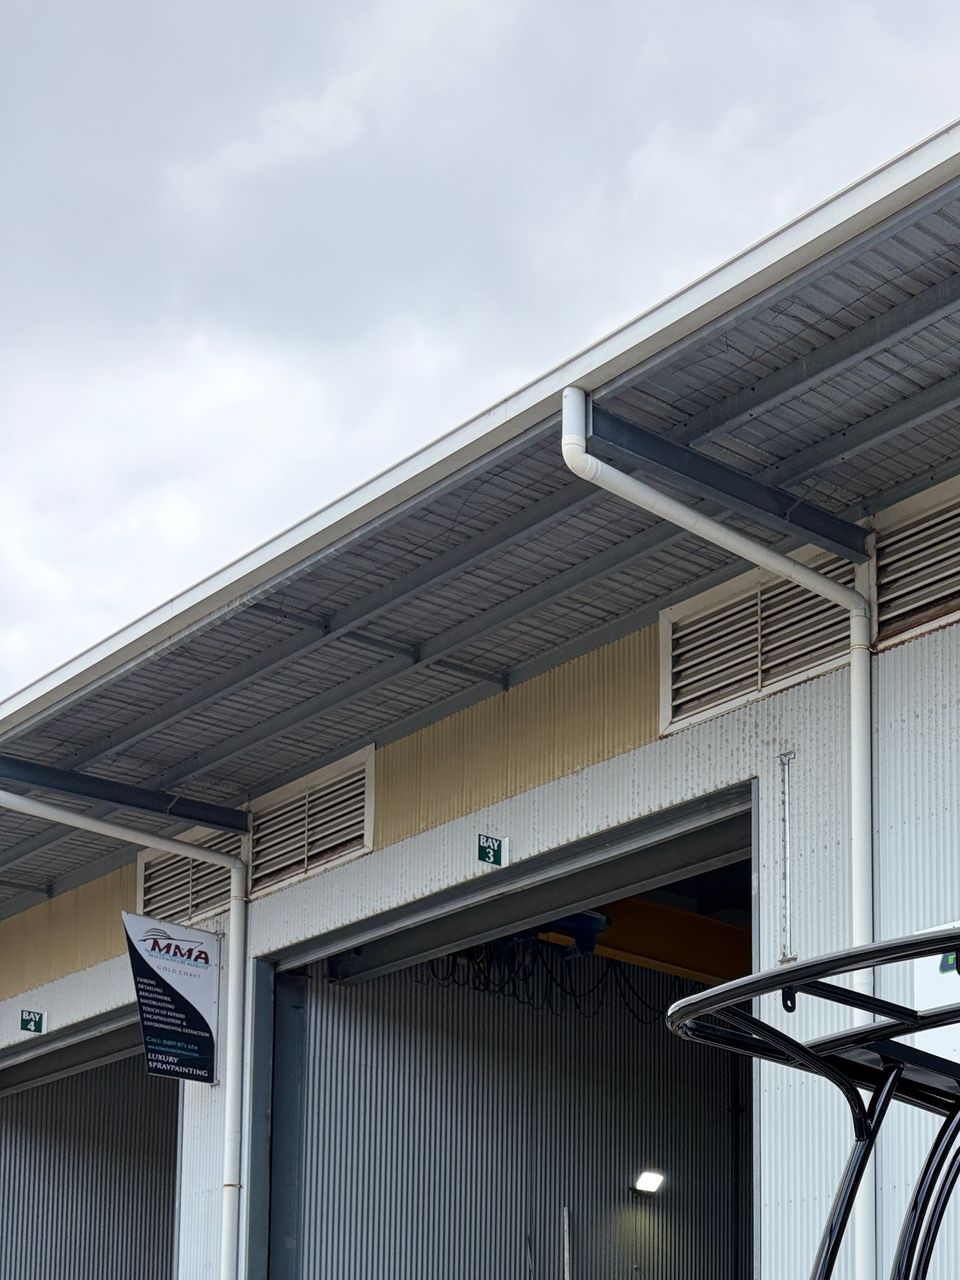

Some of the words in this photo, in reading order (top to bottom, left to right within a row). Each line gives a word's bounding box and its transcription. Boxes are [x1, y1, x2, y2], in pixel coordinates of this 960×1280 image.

[480, 835, 500, 850] BAY
[485, 848, 494, 863] 3
[150, 939, 210, 965] MMA
[157, 964, 177, 974] GOLD
[178, 969, 201, 979] COAST
[23, 1011, 41, 1022] BAY
[27, 1021, 35, 1031] 4
[148, 1052, 179, 1064] LUXURY
[148, 1061, 208, 1077] SPRAYPAINTING
